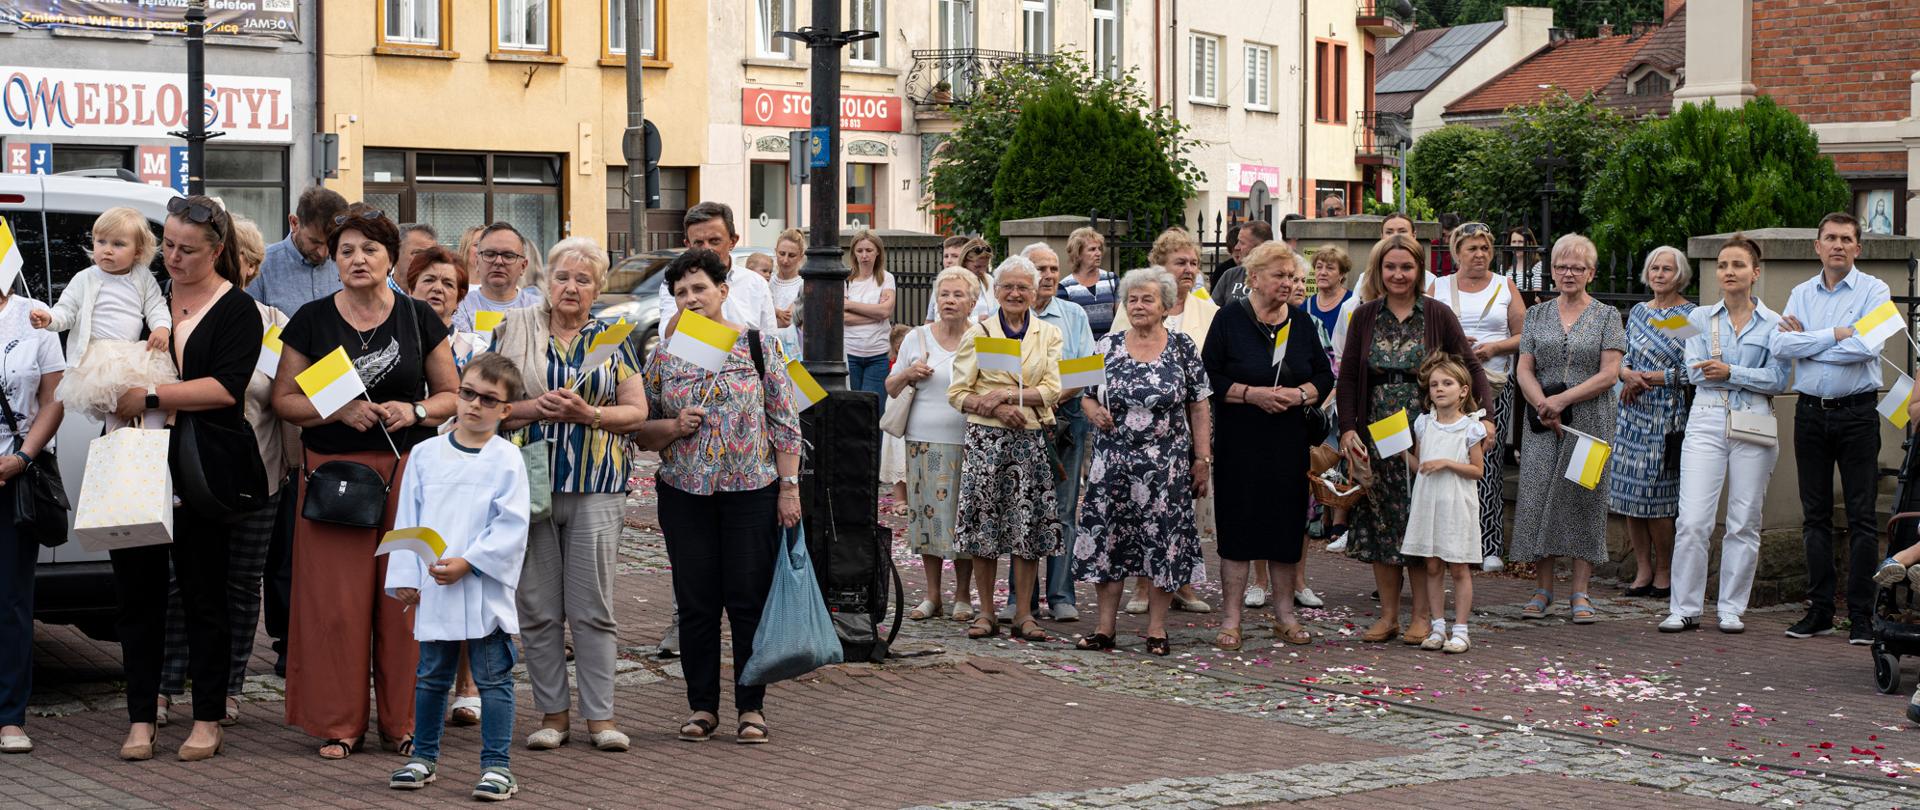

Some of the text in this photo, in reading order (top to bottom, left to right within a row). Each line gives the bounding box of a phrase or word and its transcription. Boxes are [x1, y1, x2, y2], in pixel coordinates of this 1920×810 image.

[127, 16, 135, 28] 6
[782, 94, 888, 119] STOTOLOG
[902, 179, 911, 190] 17
